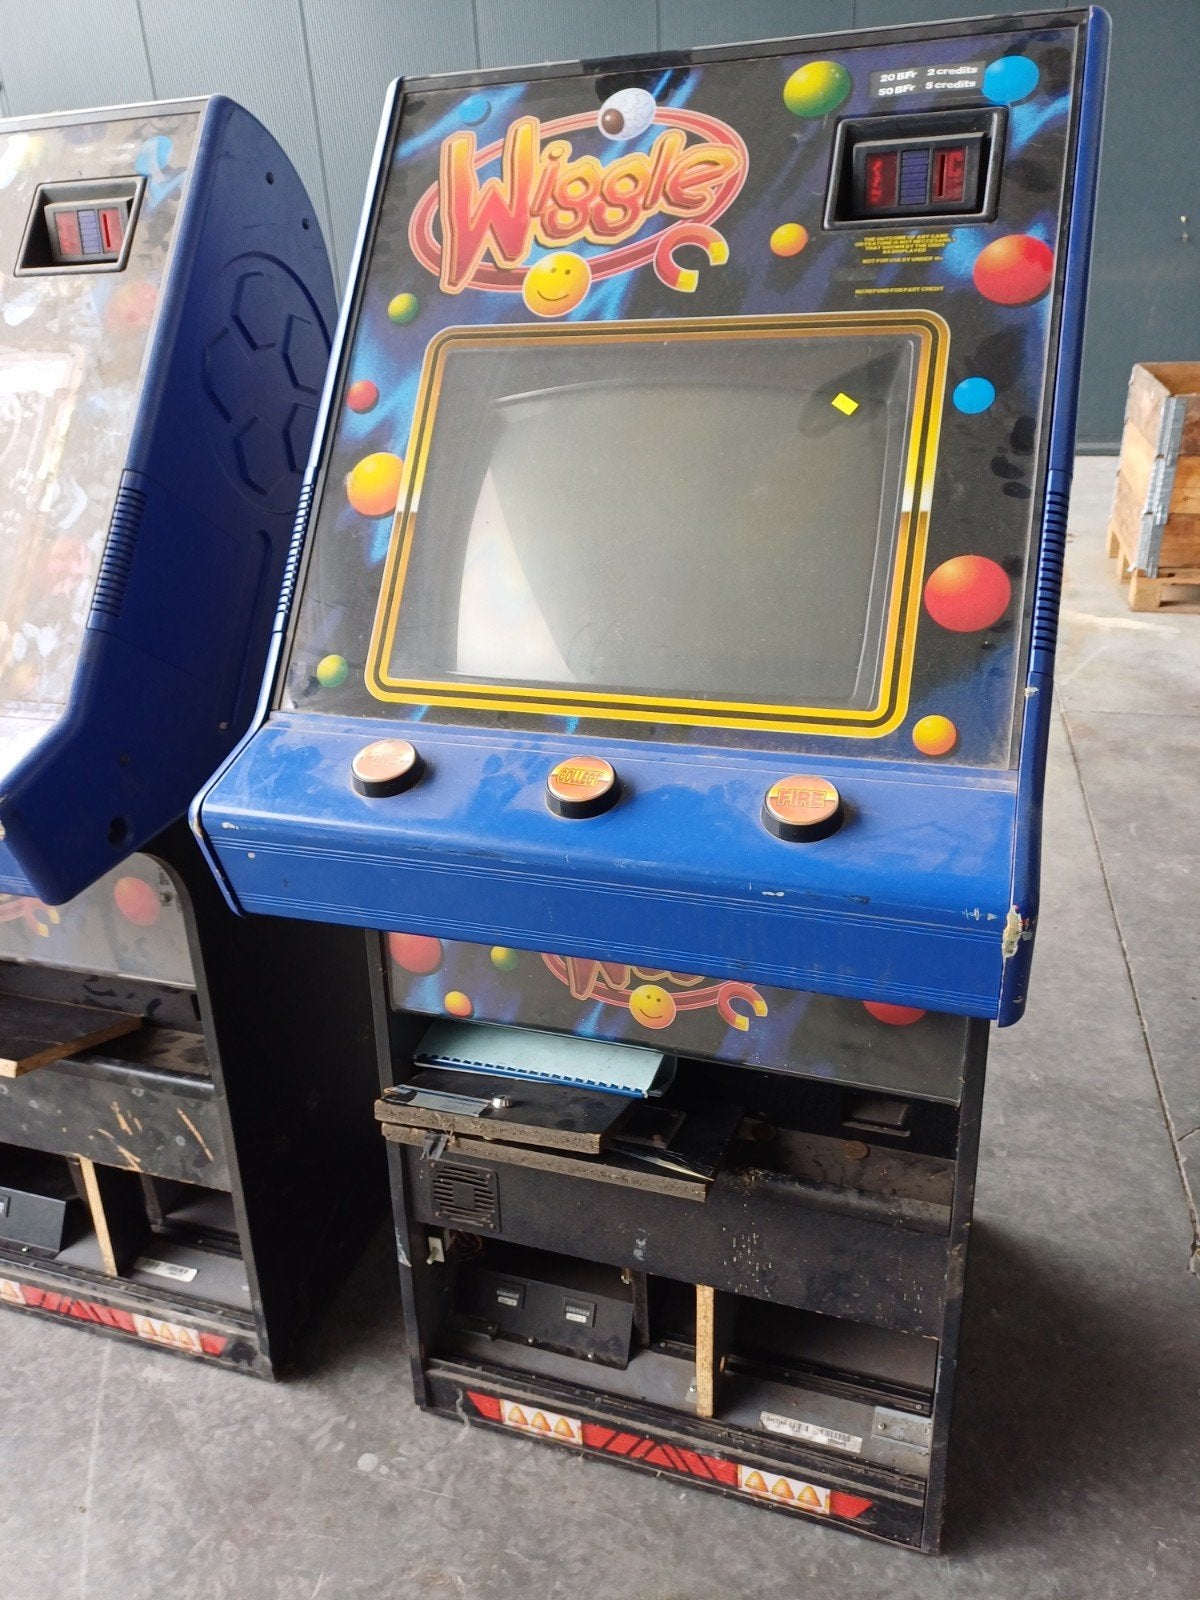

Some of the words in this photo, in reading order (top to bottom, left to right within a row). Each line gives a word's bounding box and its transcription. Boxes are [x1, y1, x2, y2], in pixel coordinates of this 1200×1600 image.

[880, 73, 896, 82] 20
[896, 70, 918, 81] BFr
[926, 68, 935, 76] 2
[936, 66, 978, 75] credits
[878, 87, 894, 95] 50
[894, 84, 917, 94] BFr
[925, 81, 934, 89] 5
[934, 80, 977, 89] credits
[439, 115, 743, 295] Wiggle
[556, 766, 603, 782] COLLECT
[777, 788, 826, 808] FIRE
